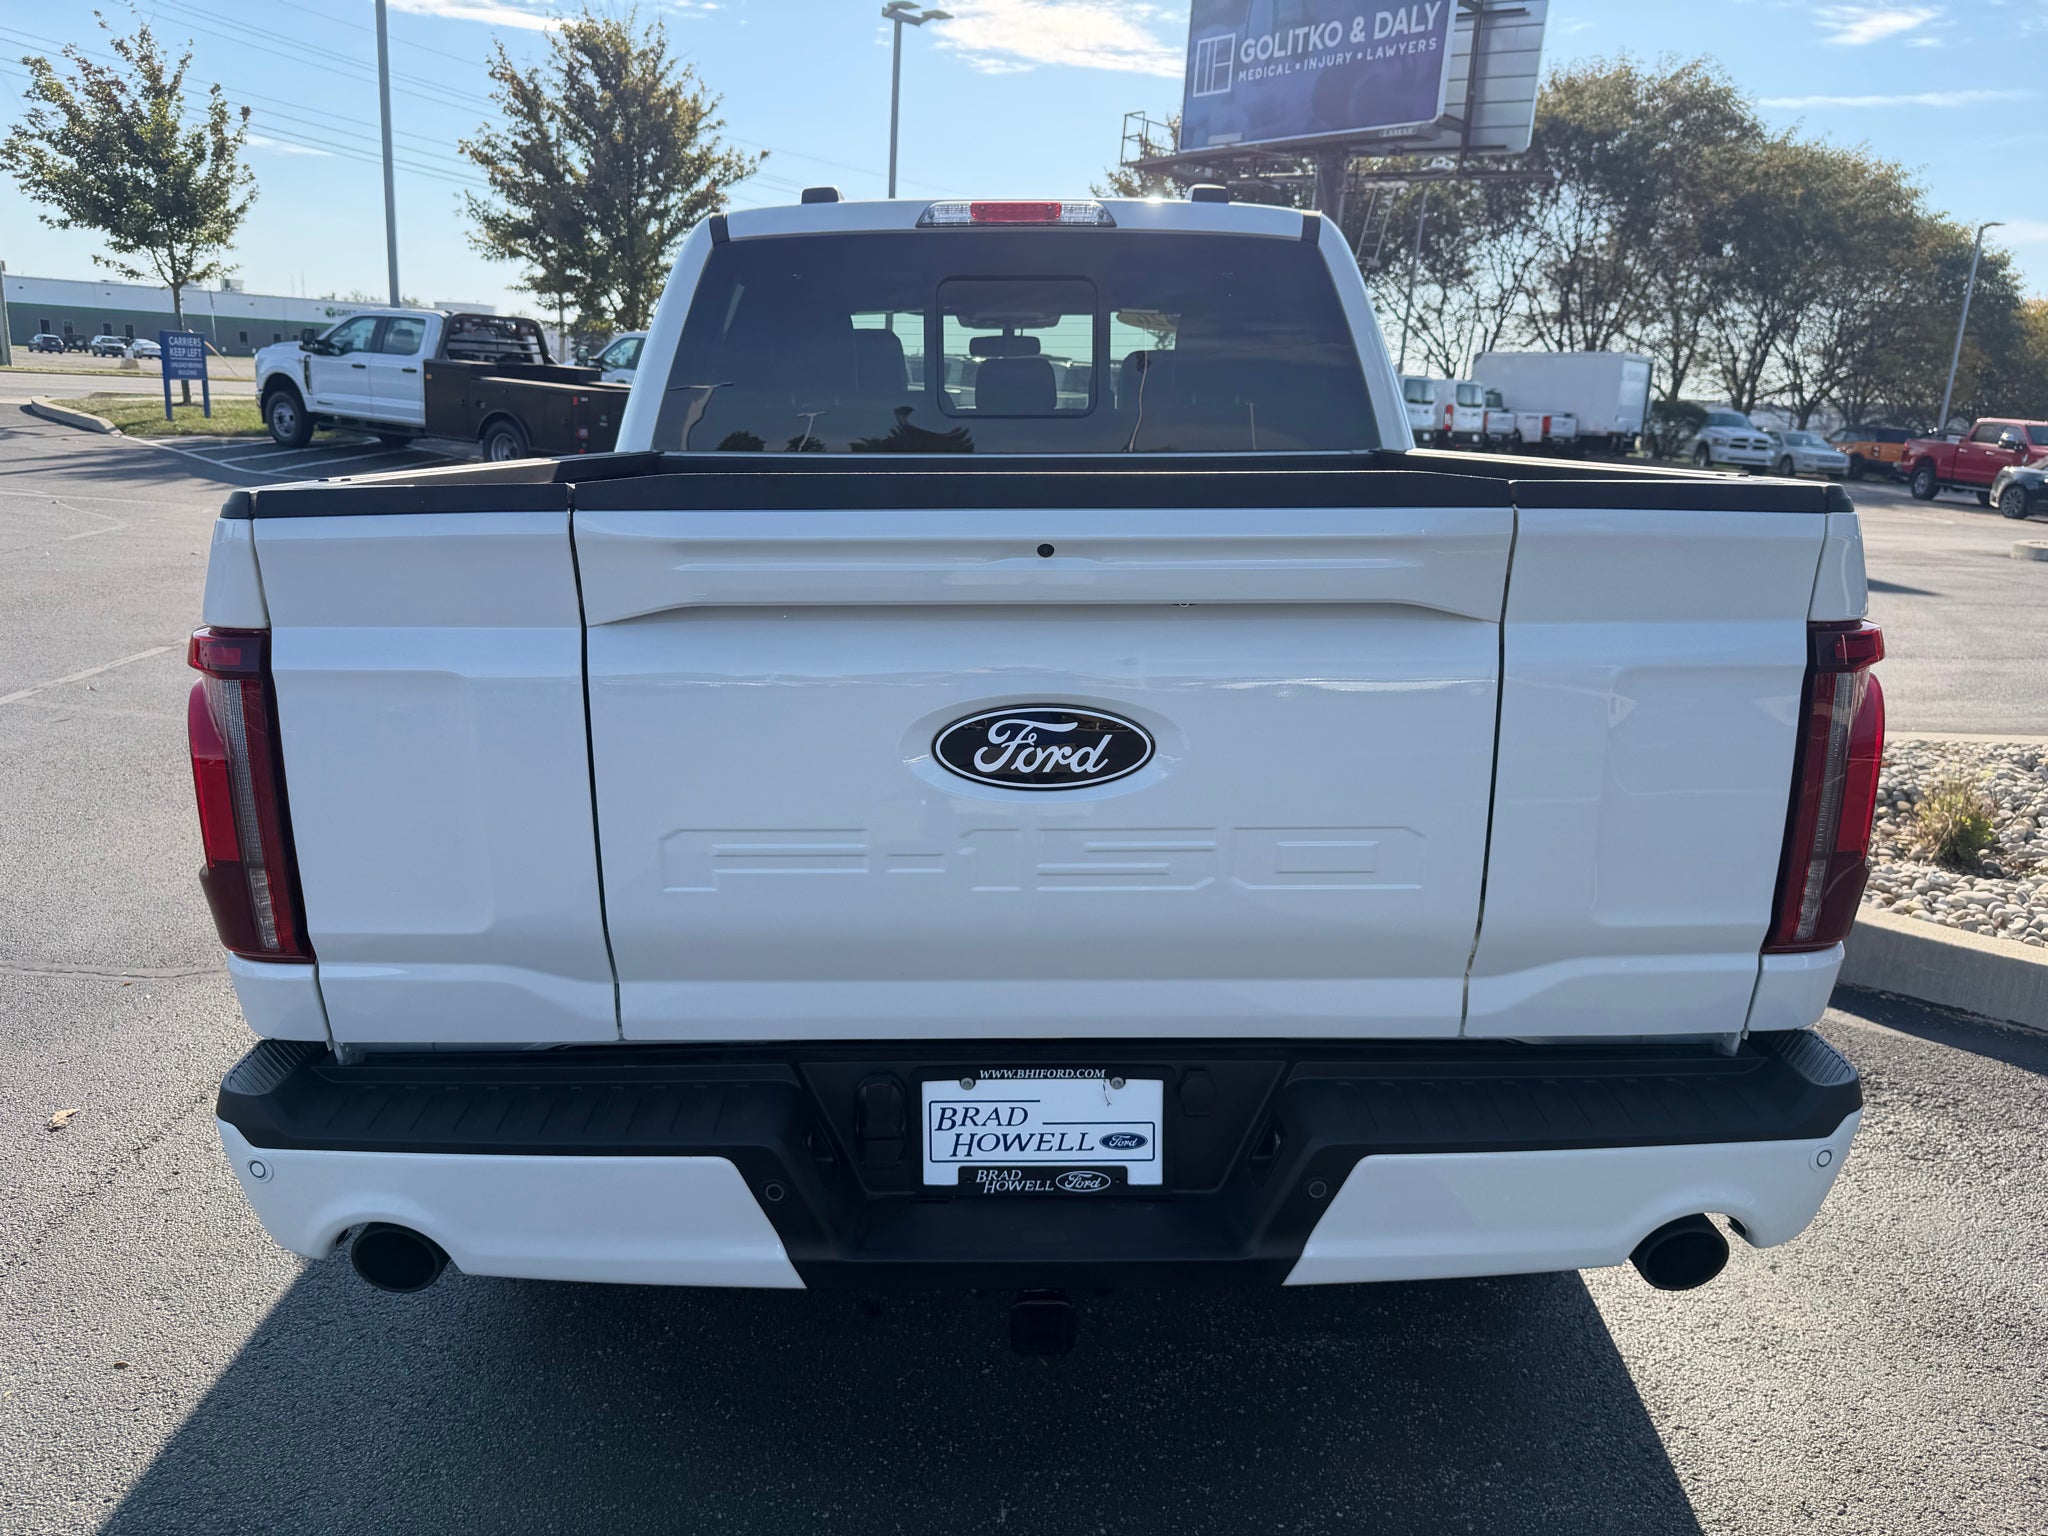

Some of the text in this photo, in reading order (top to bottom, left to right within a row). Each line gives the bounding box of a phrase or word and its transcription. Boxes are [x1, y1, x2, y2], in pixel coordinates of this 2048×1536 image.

[1240, 0, 1442, 64] GOLITKO & DALY
[1238, 37, 1438, 82] MEDICAL INJURY LAWYERS
[168, 336, 202, 347] CARRIERS
[170, 347, 202, 357] KEEP LEFT
[973, 718, 1112, 775] Ford
[659, 826, 1426, 893] F-150
[979, 1069, 1106, 1079] WWW.BHIFORD.COM
[934, 1106, 1029, 1132] BRAD
[949, 1132, 1138, 1158] HOWELL Ford
[976, 1169, 1022, 1183] BRAD
[983, 1173, 1102, 1194] HOWELL Ford
